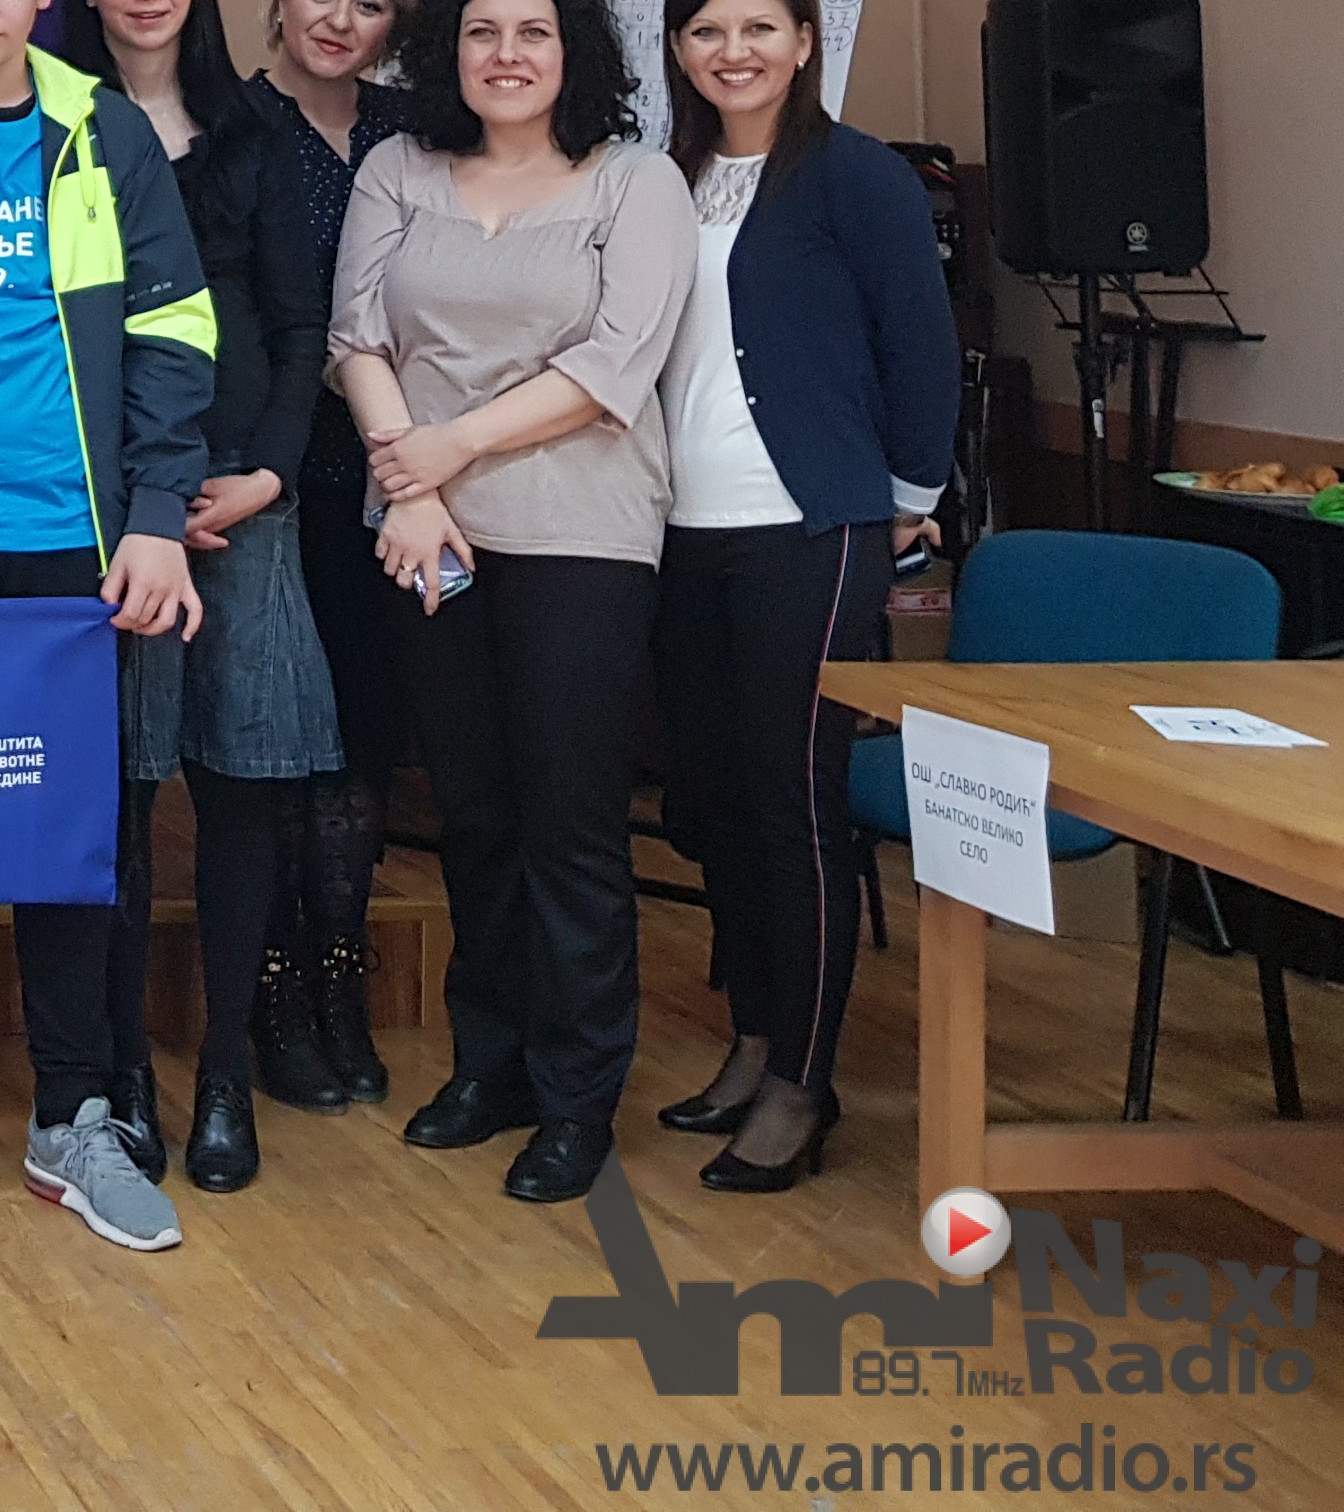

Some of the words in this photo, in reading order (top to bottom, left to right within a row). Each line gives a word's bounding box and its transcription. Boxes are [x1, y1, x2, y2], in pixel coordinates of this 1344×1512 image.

[912, 762, 931, 783] ОШ
[925, 798, 979, 831] БАНАТСКО
[982, 818, 1023, 847] ВЕЛИКО
[960, 840, 988, 864] СЕЛО
